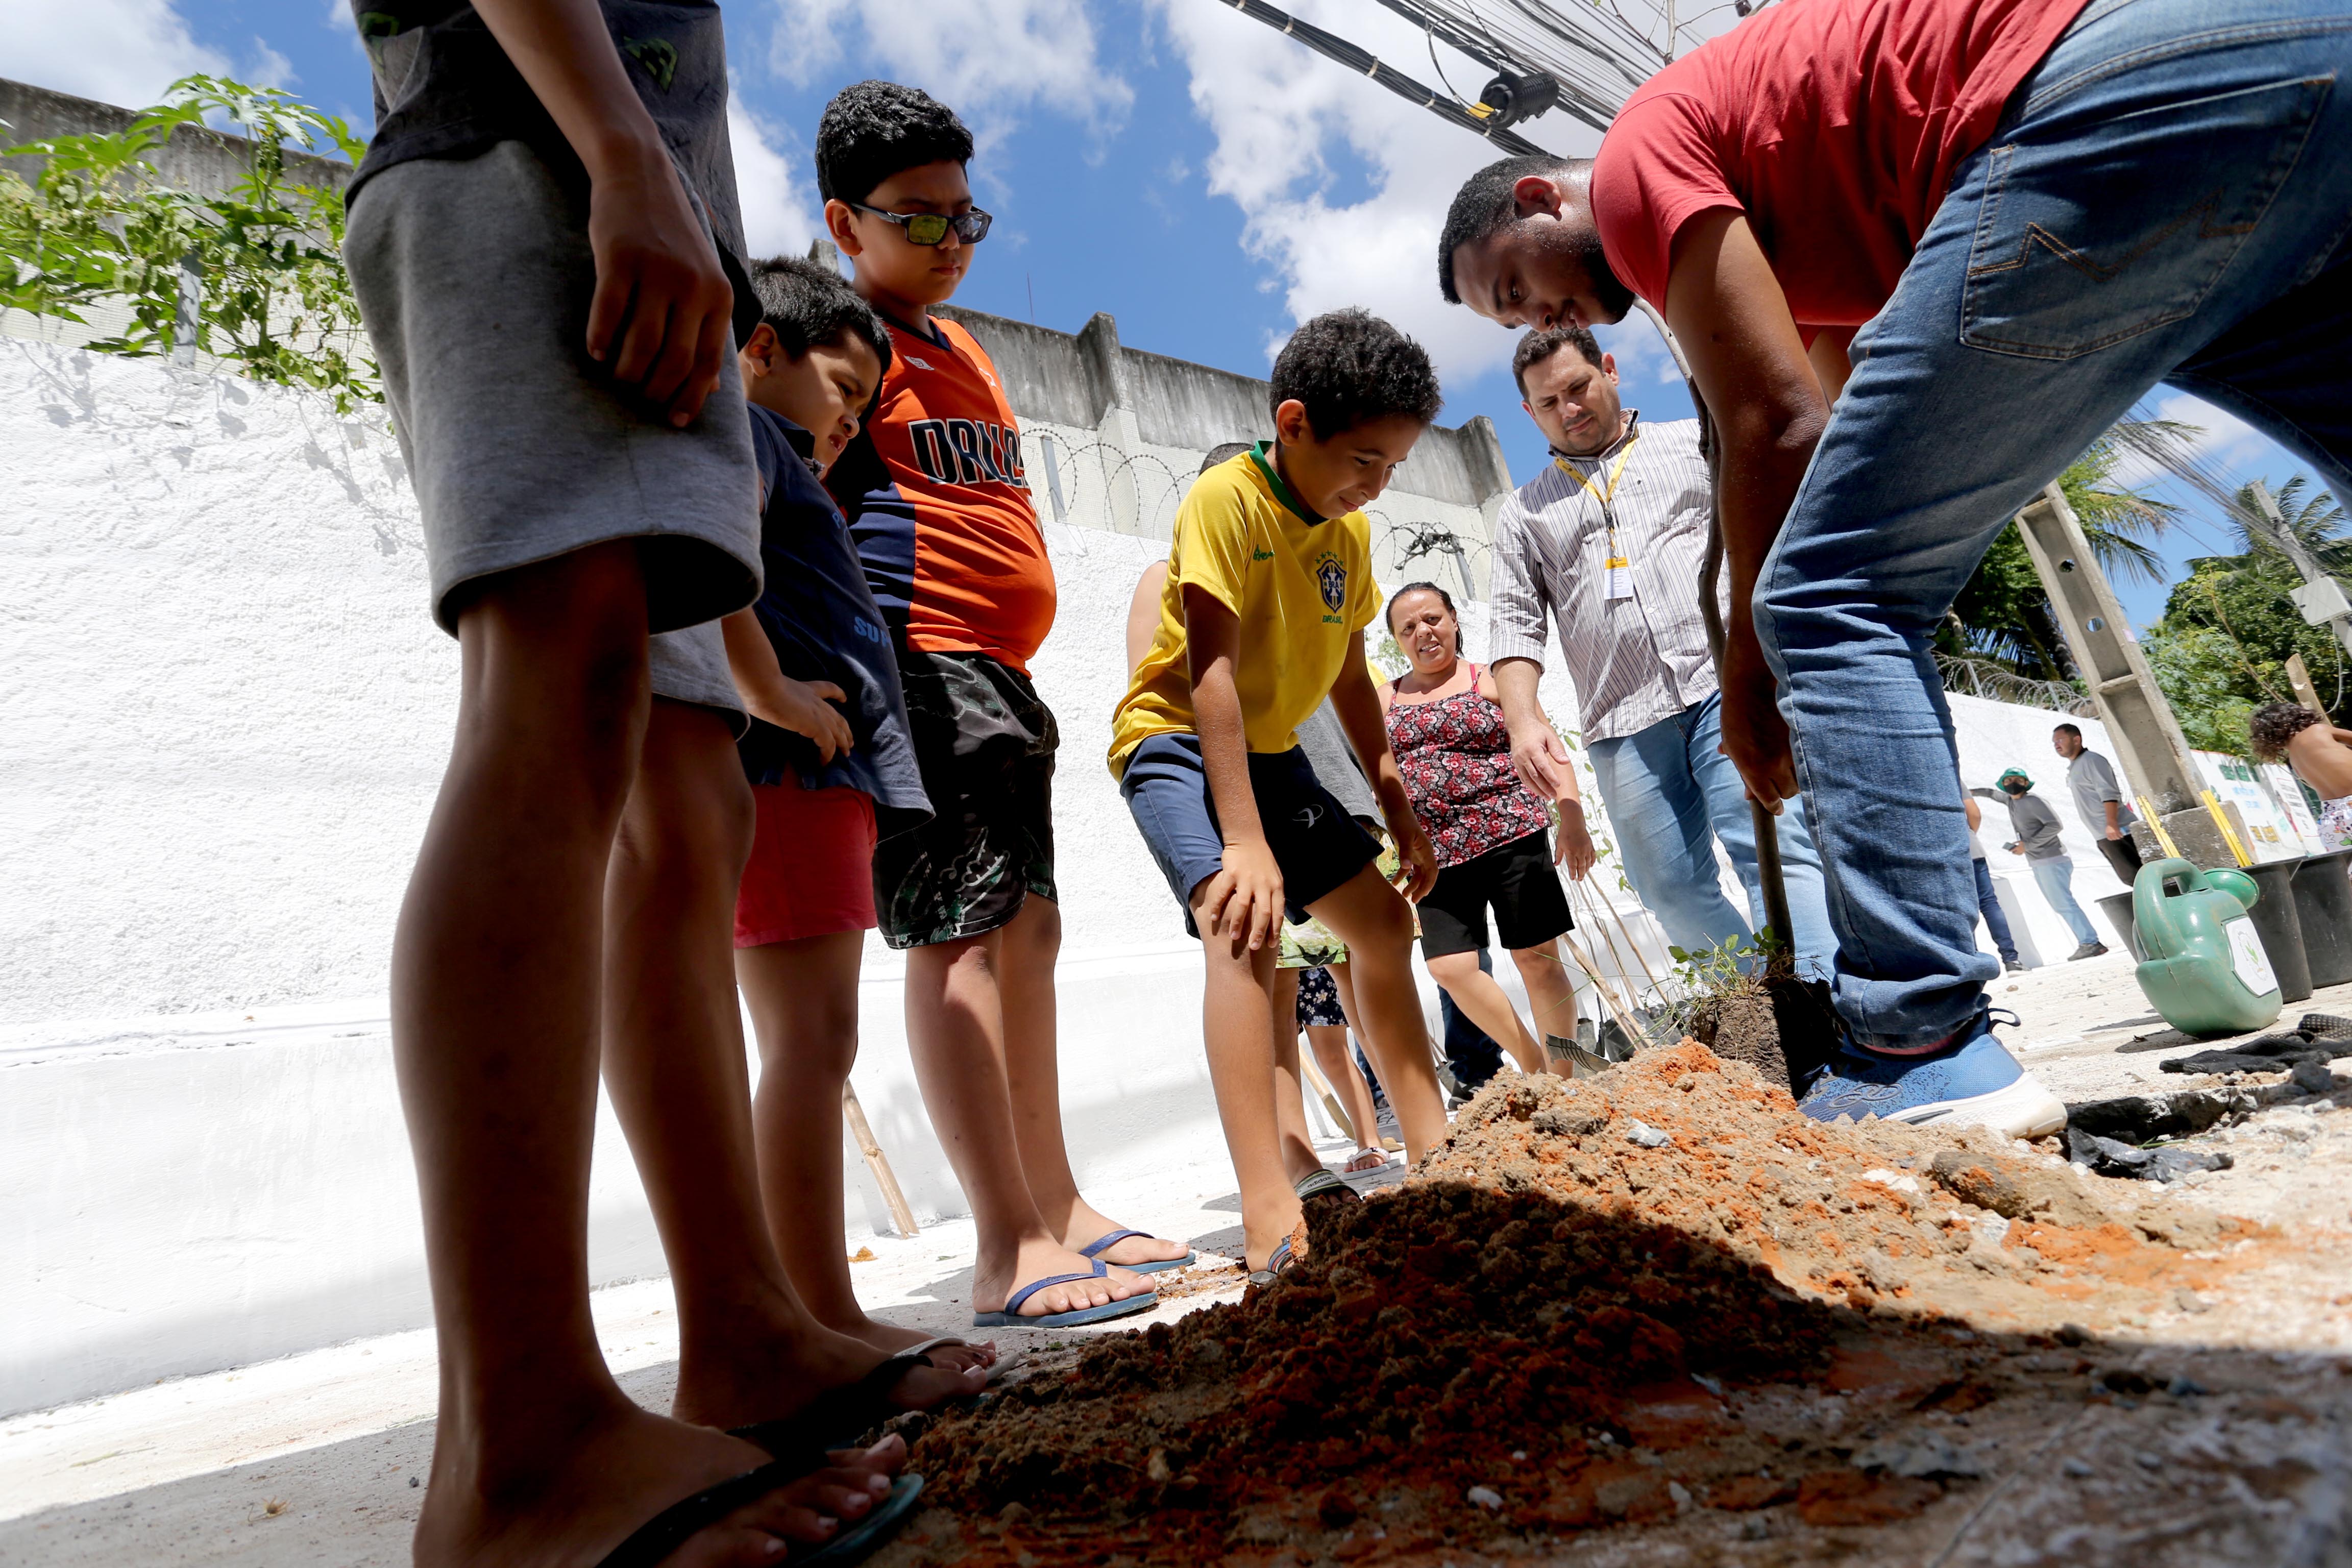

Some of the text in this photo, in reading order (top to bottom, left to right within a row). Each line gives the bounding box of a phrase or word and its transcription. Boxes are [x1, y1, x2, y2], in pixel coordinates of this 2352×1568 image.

[908, 418, 1030, 488] DALLA
[1322, 615, 1343, 624] BRASIL
[1307, 1176, 1332, 1188] adidas
